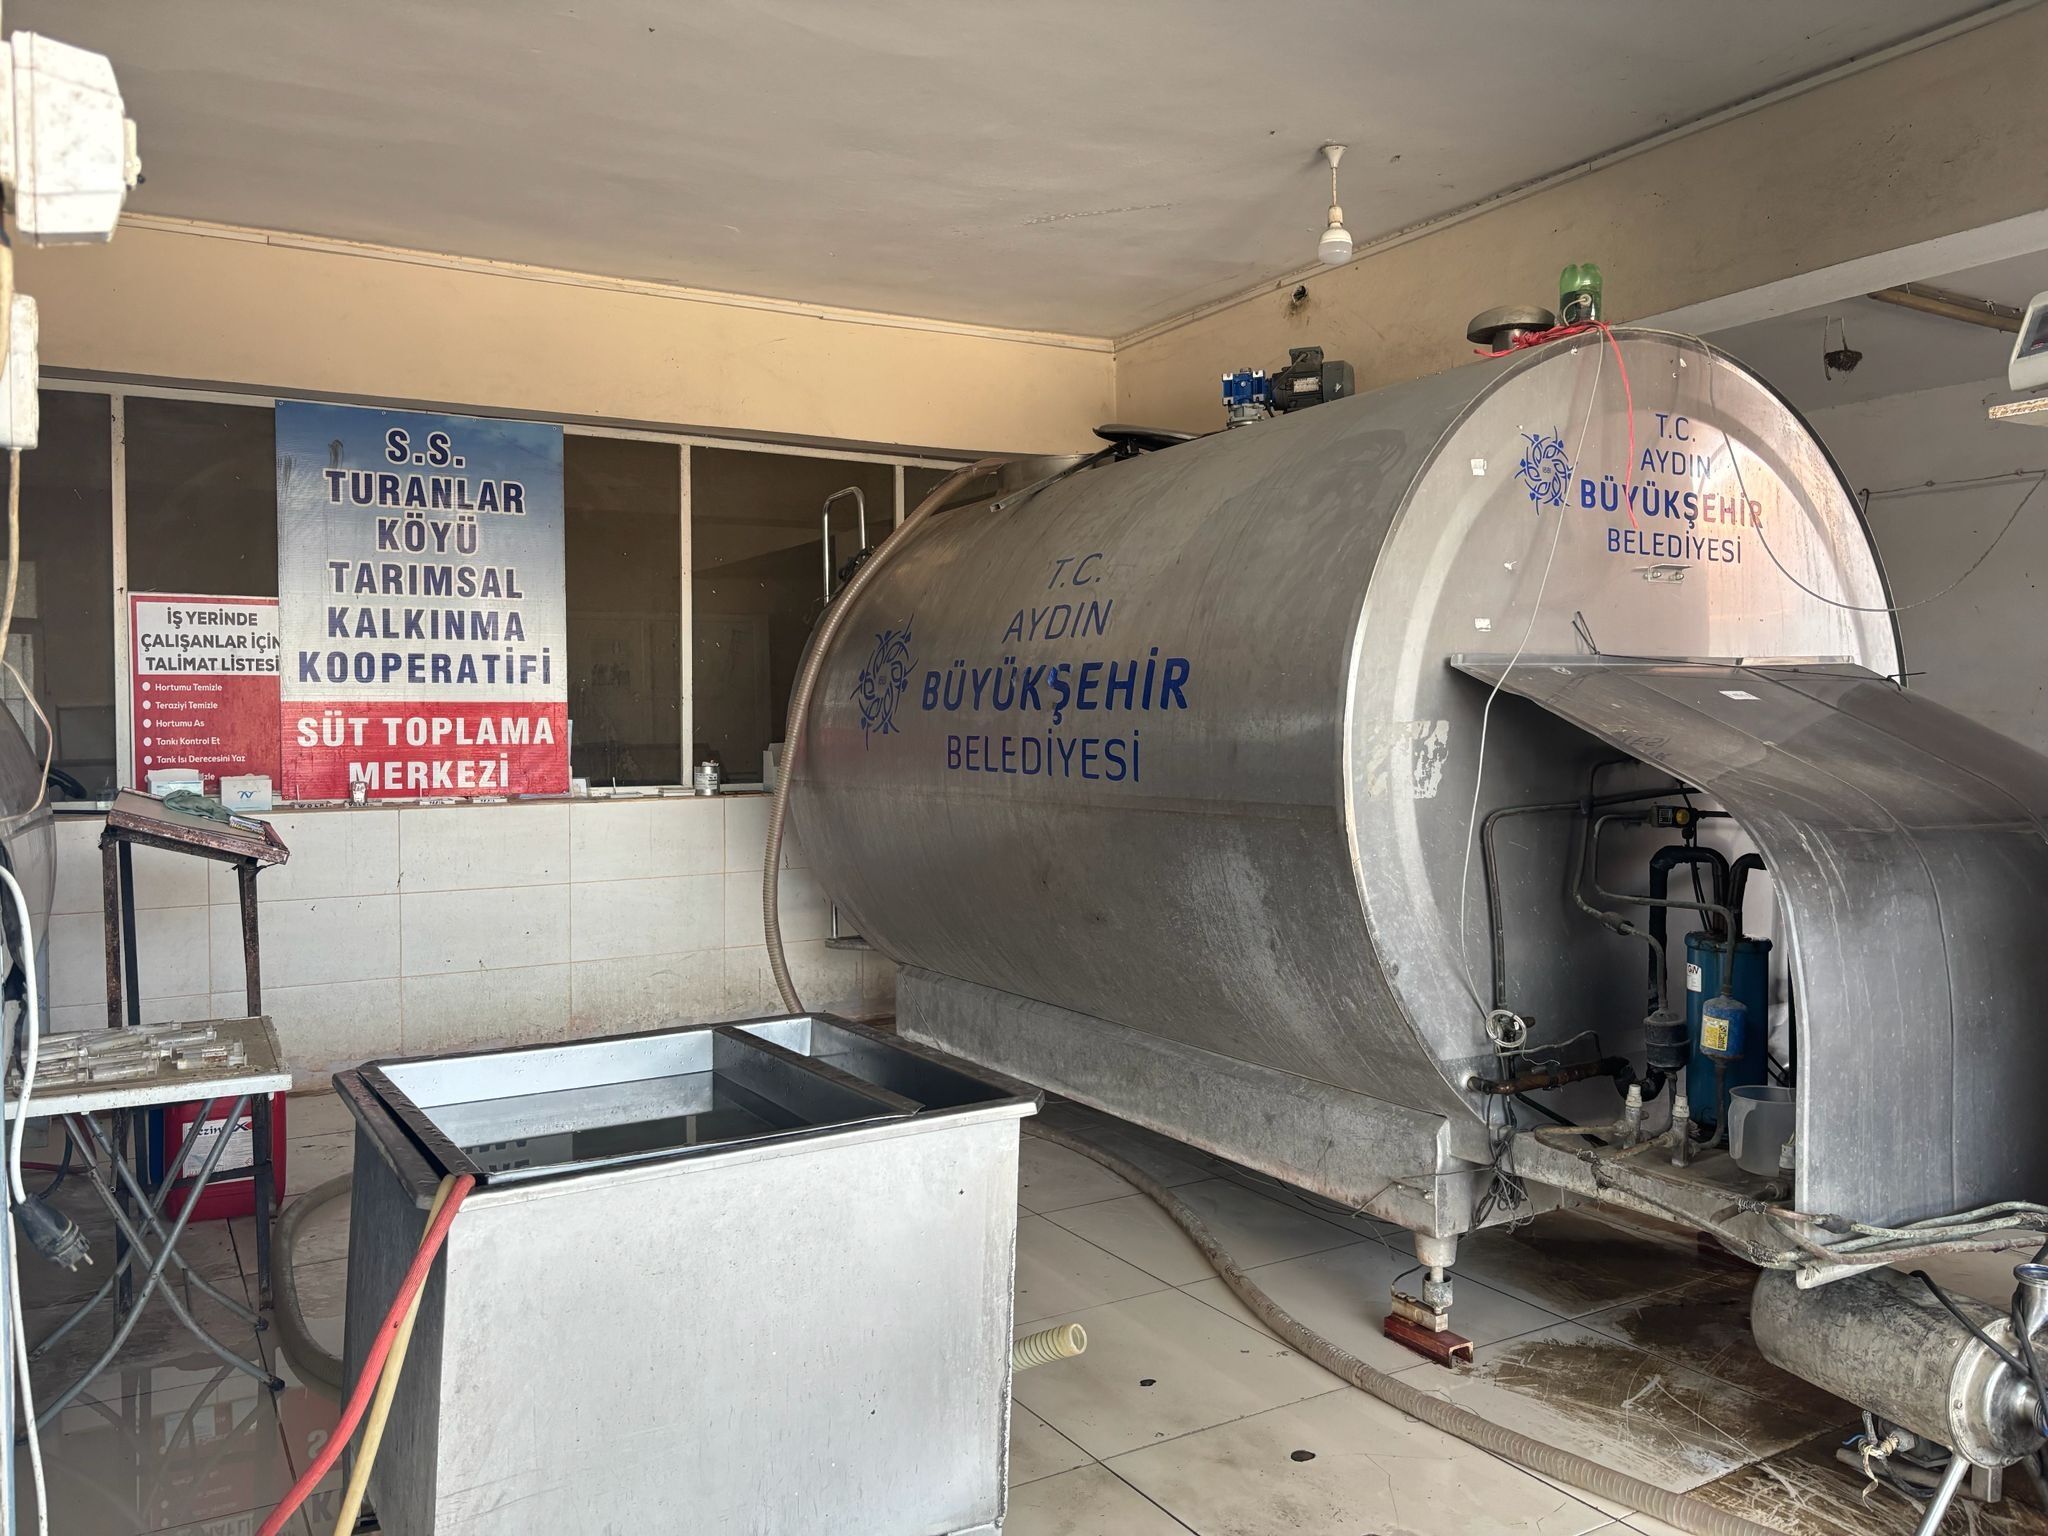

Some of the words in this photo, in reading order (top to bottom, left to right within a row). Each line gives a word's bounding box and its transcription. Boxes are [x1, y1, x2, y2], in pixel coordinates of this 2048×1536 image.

[1655, 413, 1696, 442] T.C.
[386, 429, 465, 468] S.S.
[1640, 448, 1711, 479] AYDIN
[325, 469, 525, 515] TURANLAR
[1580, 475, 1763, 530] BÜYÜKŞEHİR
[377, 512, 479, 555] KÖYÜ
[1607, 528, 1742, 564] BELEDİYESİ
[329, 560, 524, 599] TARIMSAL
[1048, 553, 1103, 589] T.C.
[167, 607, 183, 629] İŞ
[186, 608, 258, 627] YERİNDE
[327, 605, 526, 642] KALKINMA
[1001, 599, 1113, 643] AYDIN
[141, 633, 247, 652] ÇALIŞANLAR
[145, 653, 218, 672] TALİMAT
[221, 654, 280, 672] LİSTESİ
[298, 646, 551, 685] KOOPERATİFİ
[155, 683, 192, 692] Hortumu
[193, 683, 223, 692] Temizle
[922, 646, 1191, 725] BÜYÜKŞEHİR
[155, 701, 188, 711] Teraziyi
[188, 701, 219, 710] Temizle
[155, 719, 192, 728] Hortumu
[193, 719, 205, 728] As
[156, 737, 179, 746] Tankı
[179, 737, 210, 746] Kontrol
[211, 737, 221, 746] Et
[297, 710, 369, 747] SÜT
[382, 716, 555, 747] TOPLAMA
[156, 755, 176, 764] Tank
[188, 754, 231, 764] Derecesini
[232, 754, 246, 764] Yaz
[349, 753, 509, 790] MERKEZİ
[947, 728, 1140, 783] BELEDİYESİ
